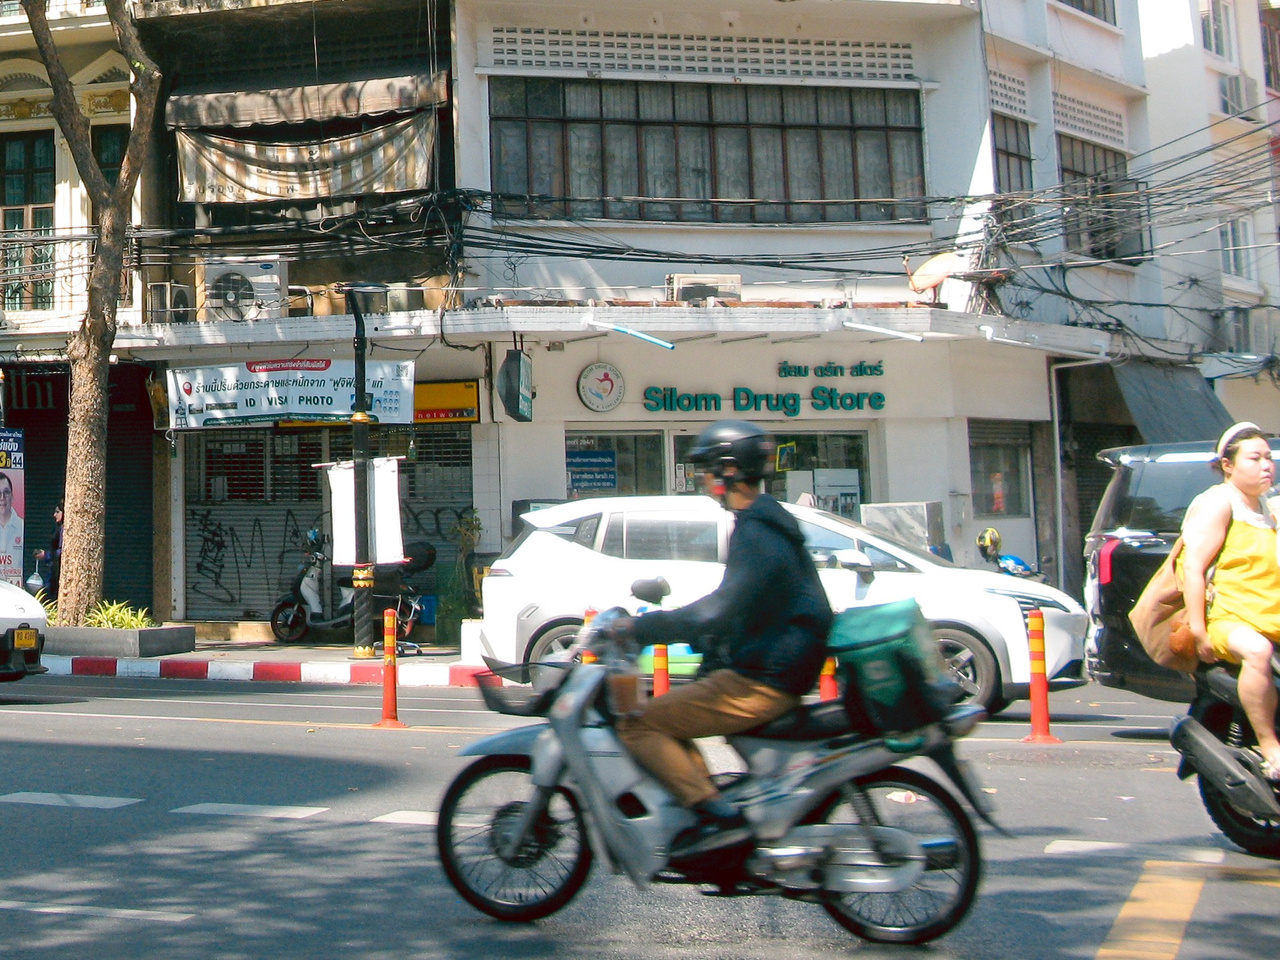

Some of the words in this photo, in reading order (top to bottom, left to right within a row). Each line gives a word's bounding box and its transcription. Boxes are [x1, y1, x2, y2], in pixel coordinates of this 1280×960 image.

[778, 360, 810, 378] สีลม
[245, 397, 256, 408] ID
[267, 395, 288, 407] VISA
[298, 395, 334, 407] PHOTO
[643, 385, 721, 412] Silom
[733, 386, 801, 417] Drug
[811, 385, 886, 411] Store
[417, 411, 469, 419] network
[13, 456, 23, 467] 44
